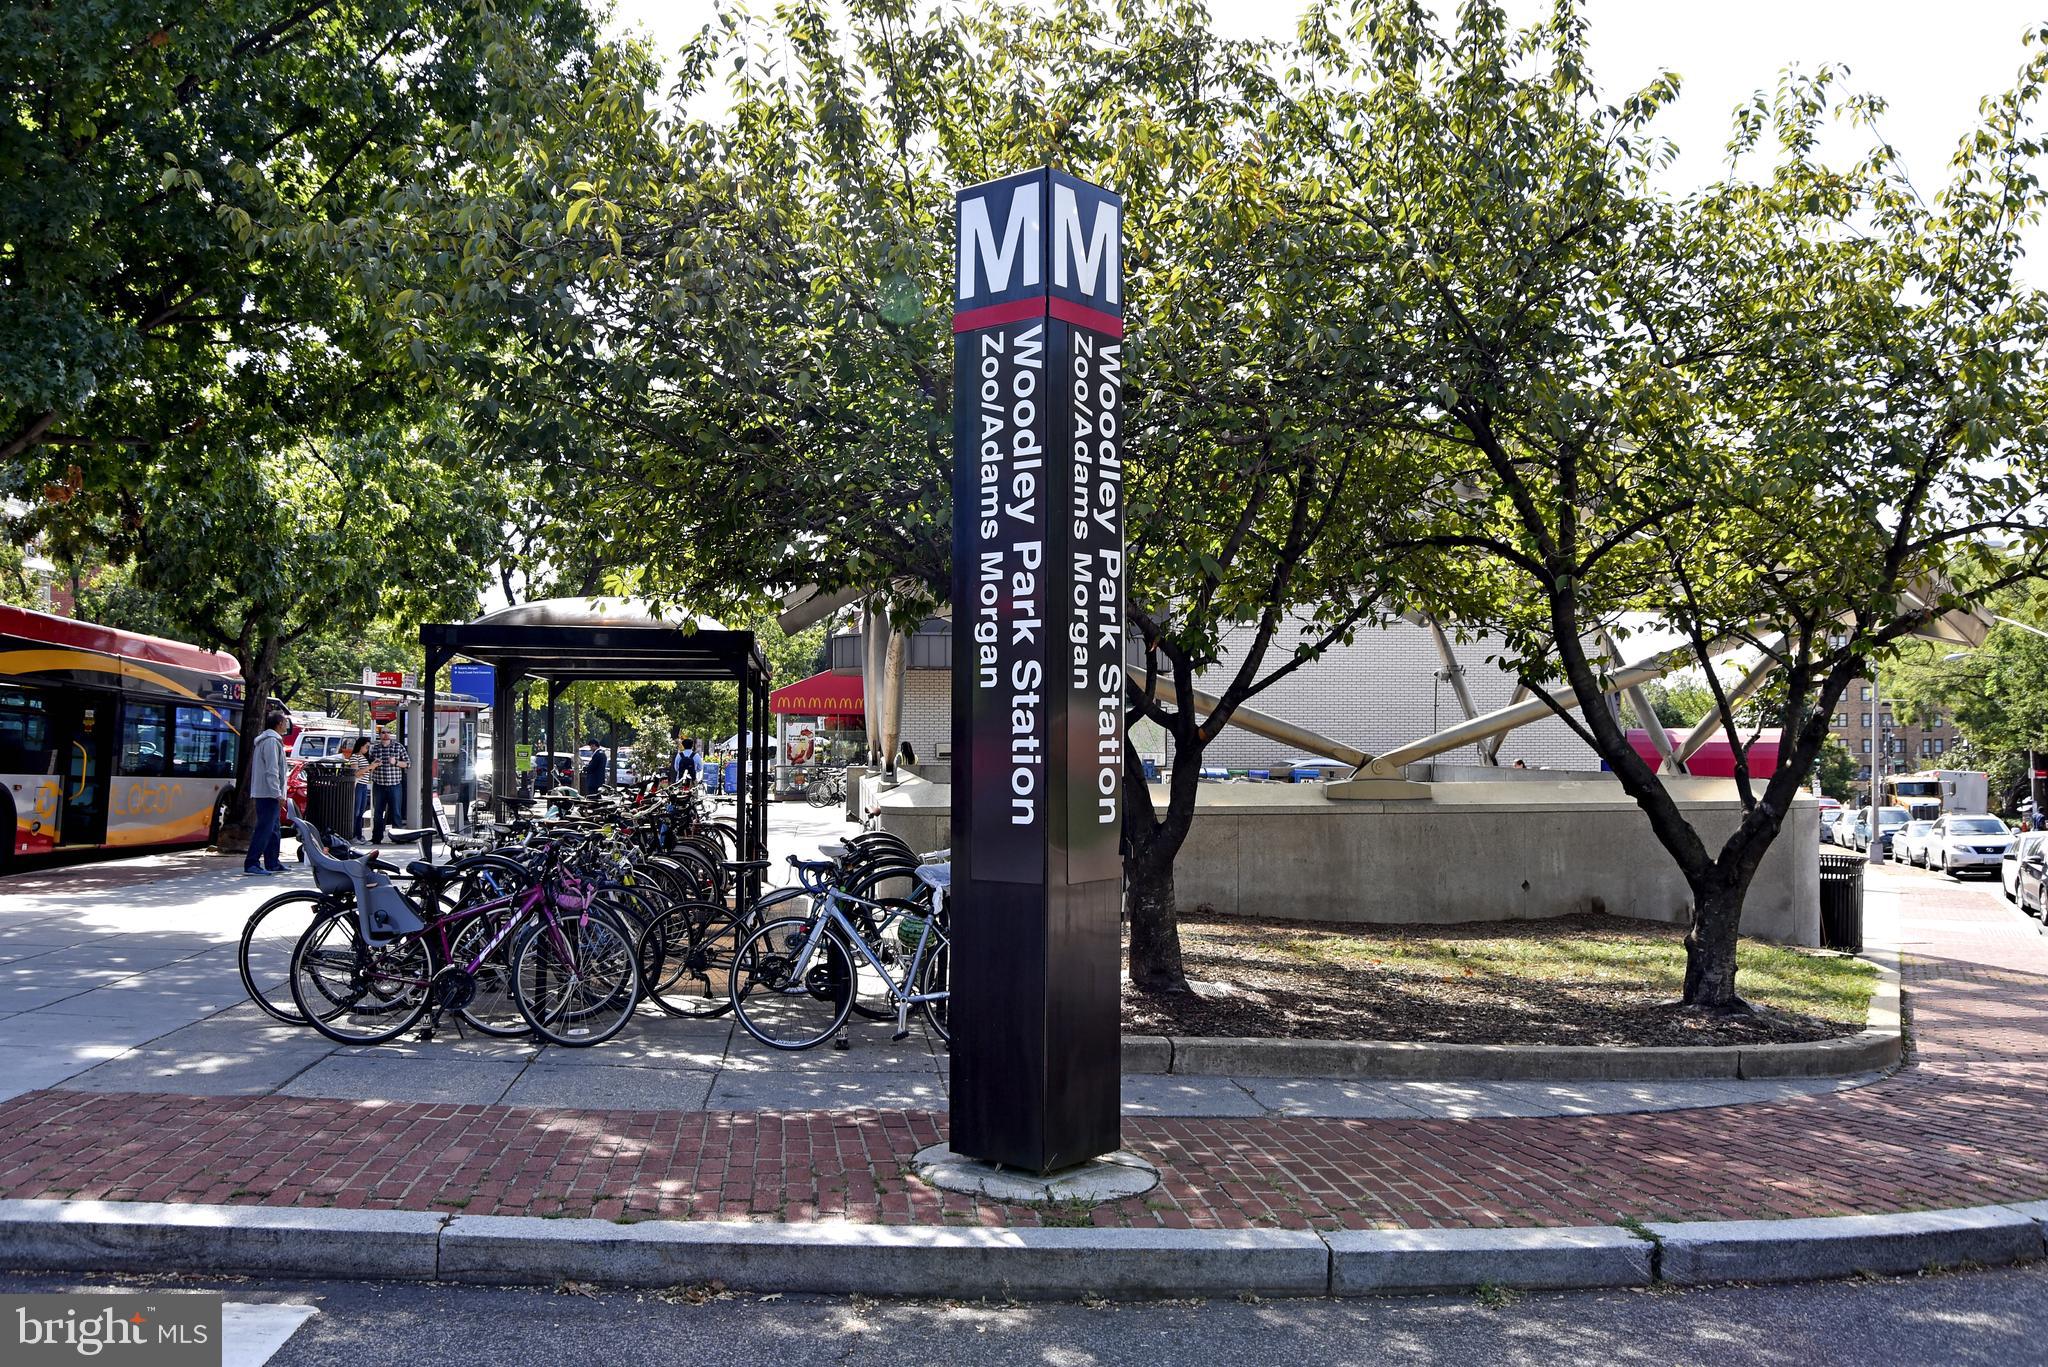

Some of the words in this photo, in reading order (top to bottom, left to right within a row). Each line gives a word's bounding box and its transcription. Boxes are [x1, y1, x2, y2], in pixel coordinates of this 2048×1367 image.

[959, 182, 1039, 300] M
[1054, 182, 1118, 305] M
[980, 331, 1004, 540] Zoo/Adams
[1005, 323, 1042, 524] Woodley
[1074, 331, 1093, 540] Zoo/Adams
[1093, 344, 1121, 534] Woodley
[974, 551, 1004, 688] Morgan
[1012, 540, 1042, 645] Park
[1069, 552, 1092, 689] Morgan
[1099, 548, 1121, 649] Park
[1012, 659, 1042, 825] Station
[1098, 663, 1121, 824] Station
